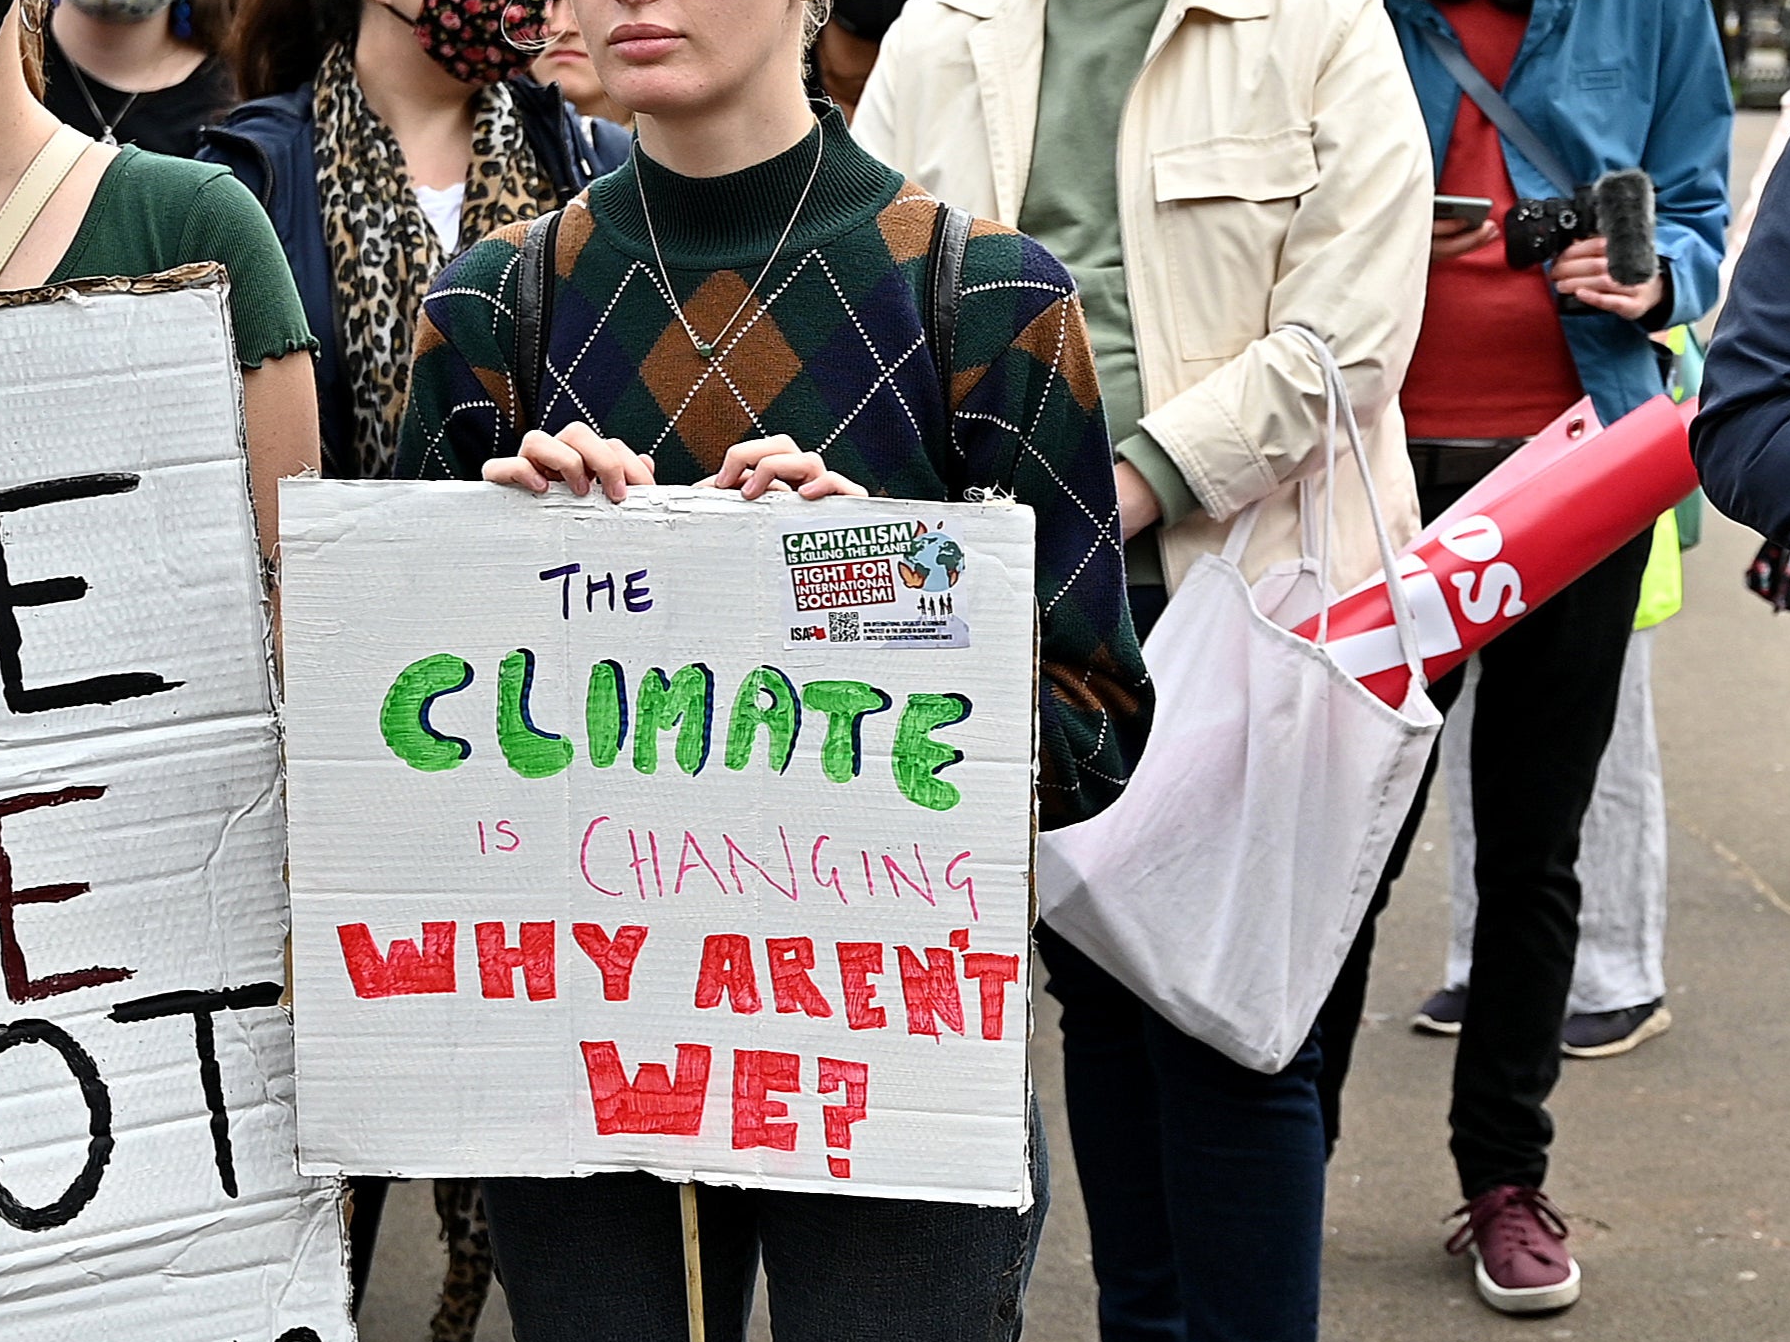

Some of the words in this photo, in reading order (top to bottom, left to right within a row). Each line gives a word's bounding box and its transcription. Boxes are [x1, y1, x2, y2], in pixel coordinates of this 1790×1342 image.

[785, 523, 911, 553] CAPITALISM
[787, 553, 799, 564] IS
[800, 548, 845, 563] KILLING
[847, 545, 868, 558] THE
[870, 540, 912, 556] PLANET
[793, 565, 847, 585] FIGHT
[853, 560, 891, 579] FOR
[796, 576, 892, 596] INTERNATIONAL
[538, 561, 655, 621] THE
[798, 592, 894, 610] SOCIALISM!
[790, 627, 810, 641] ISA
[379, 647, 973, 812] CLIMATE
[477, 818, 520, 855] IS
[578, 814, 981, 921] CHANGING
[335, 920, 650, 1002] WHY
[694, 928, 1020, 1043] AREN'T
[578, 1039, 871, 1180] WE?
